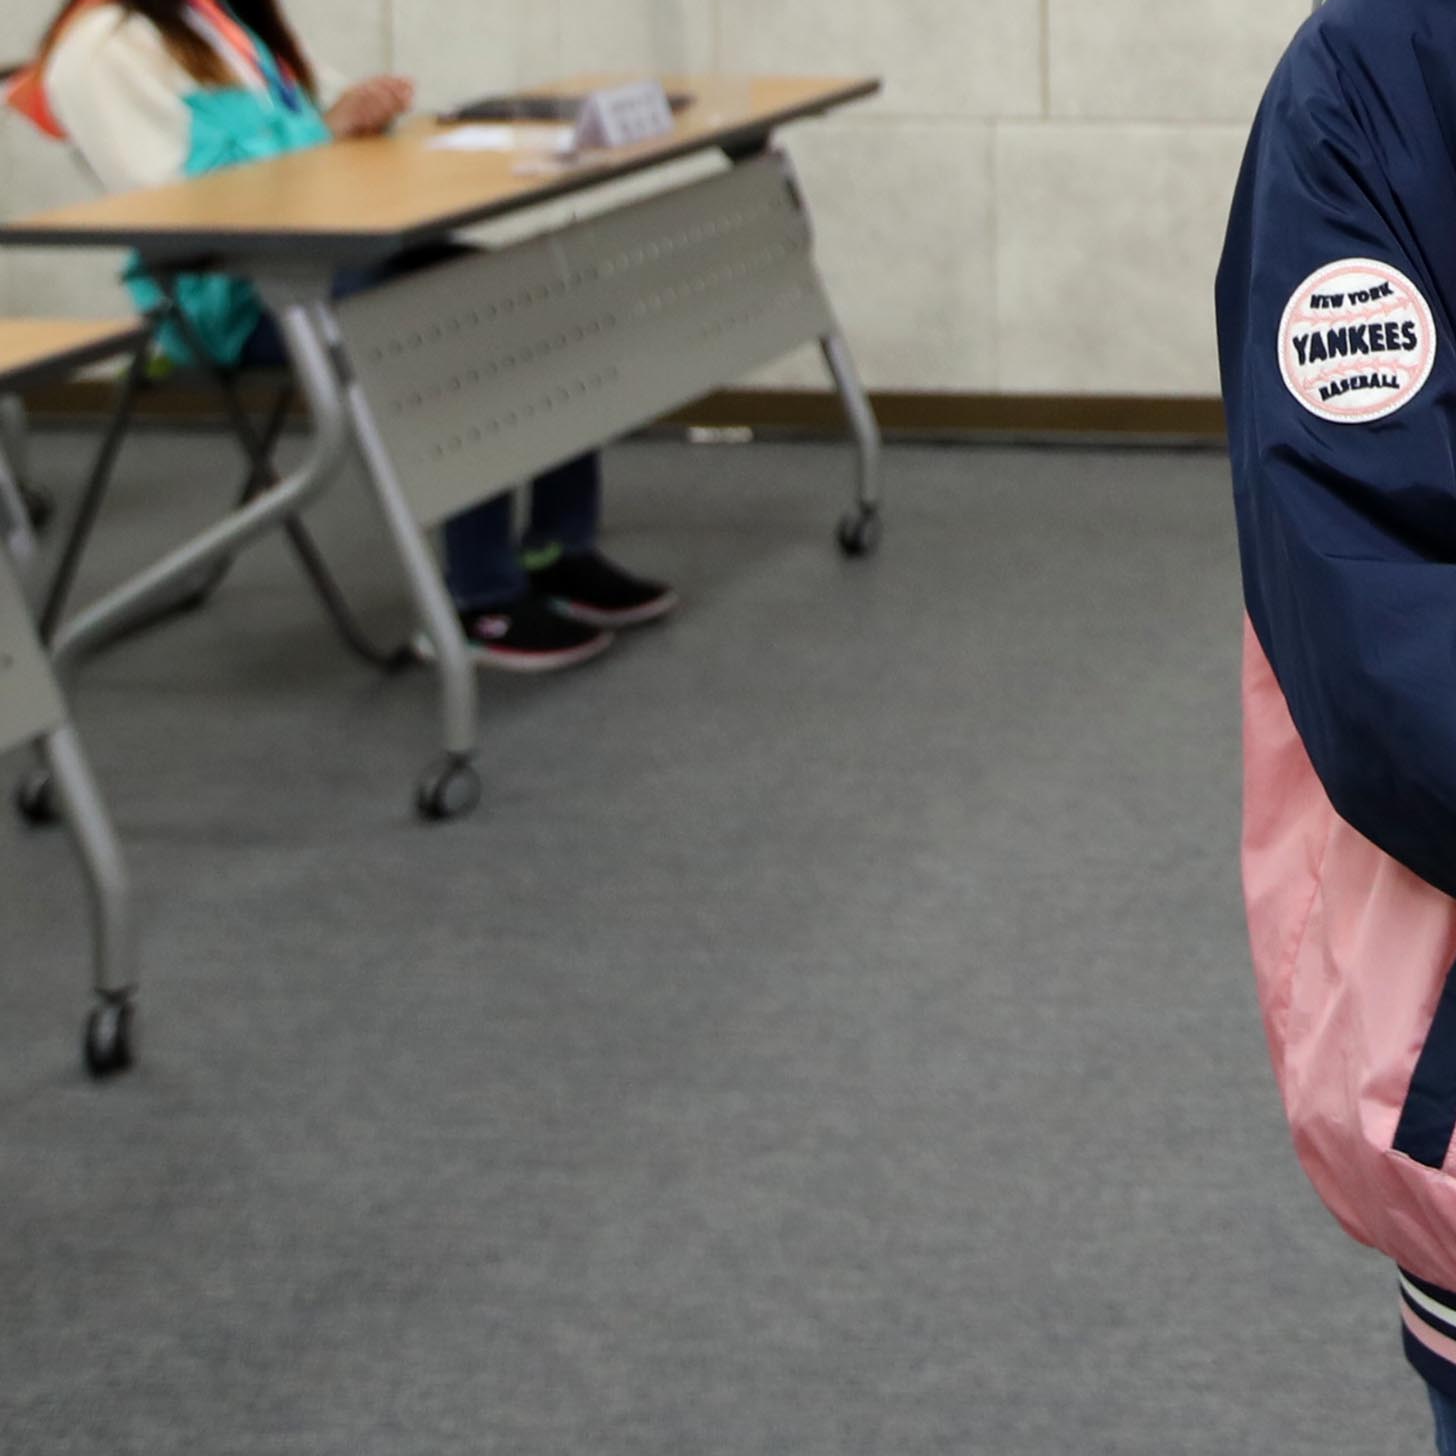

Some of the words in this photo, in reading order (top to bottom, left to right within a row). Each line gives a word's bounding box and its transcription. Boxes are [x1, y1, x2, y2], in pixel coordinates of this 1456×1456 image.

[1310, 294, 1344, 309] NEW
[1347, 281, 1393, 306] YORK
[1292, 321, 1418, 366] YANKEES
[1318, 373, 1400, 402] BASEBALL
